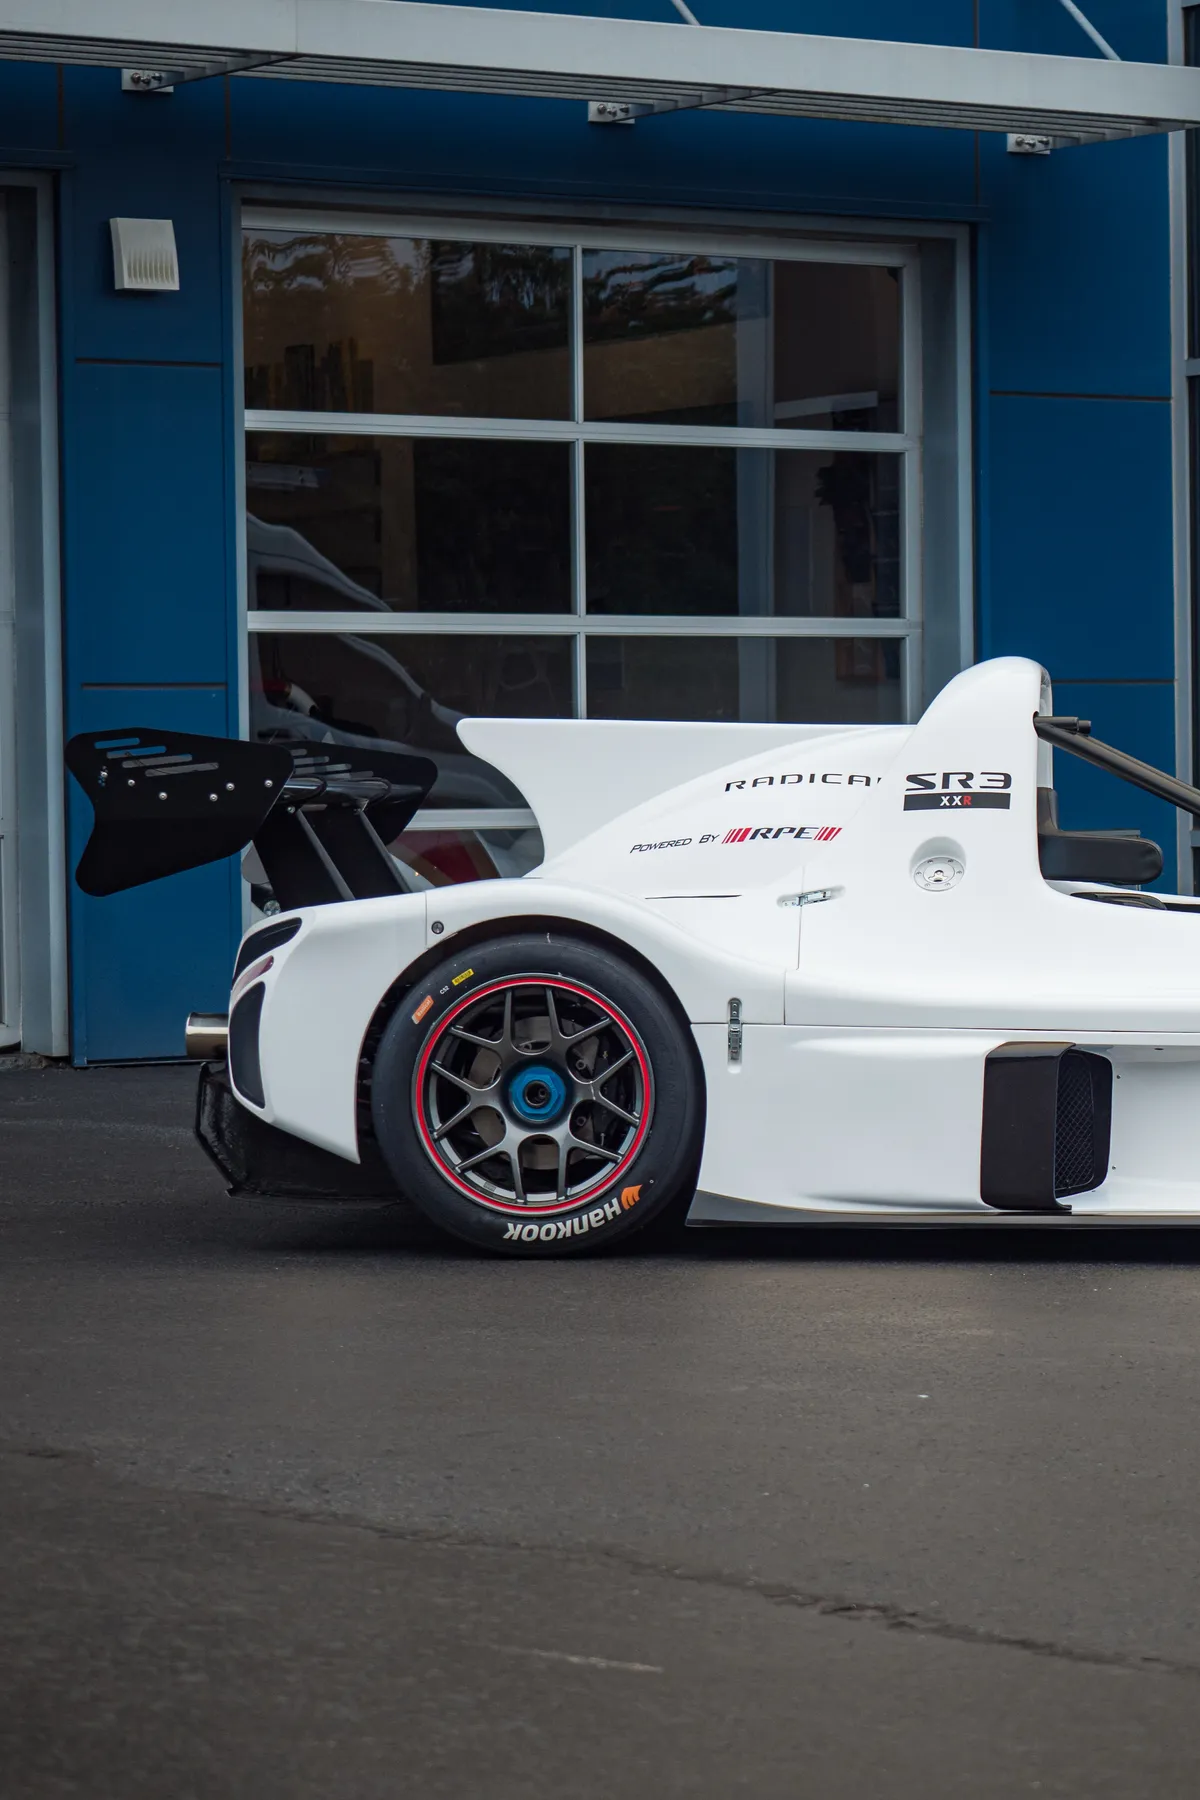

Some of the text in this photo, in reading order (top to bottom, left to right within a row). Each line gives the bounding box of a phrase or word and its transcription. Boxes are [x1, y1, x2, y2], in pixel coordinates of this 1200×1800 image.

[725, 773, 882, 792] RADICA
[905, 771, 1012, 791] SR3
[940, 795, 972, 806] XXR
[630, 826, 819, 853] POWERED BY RPE
